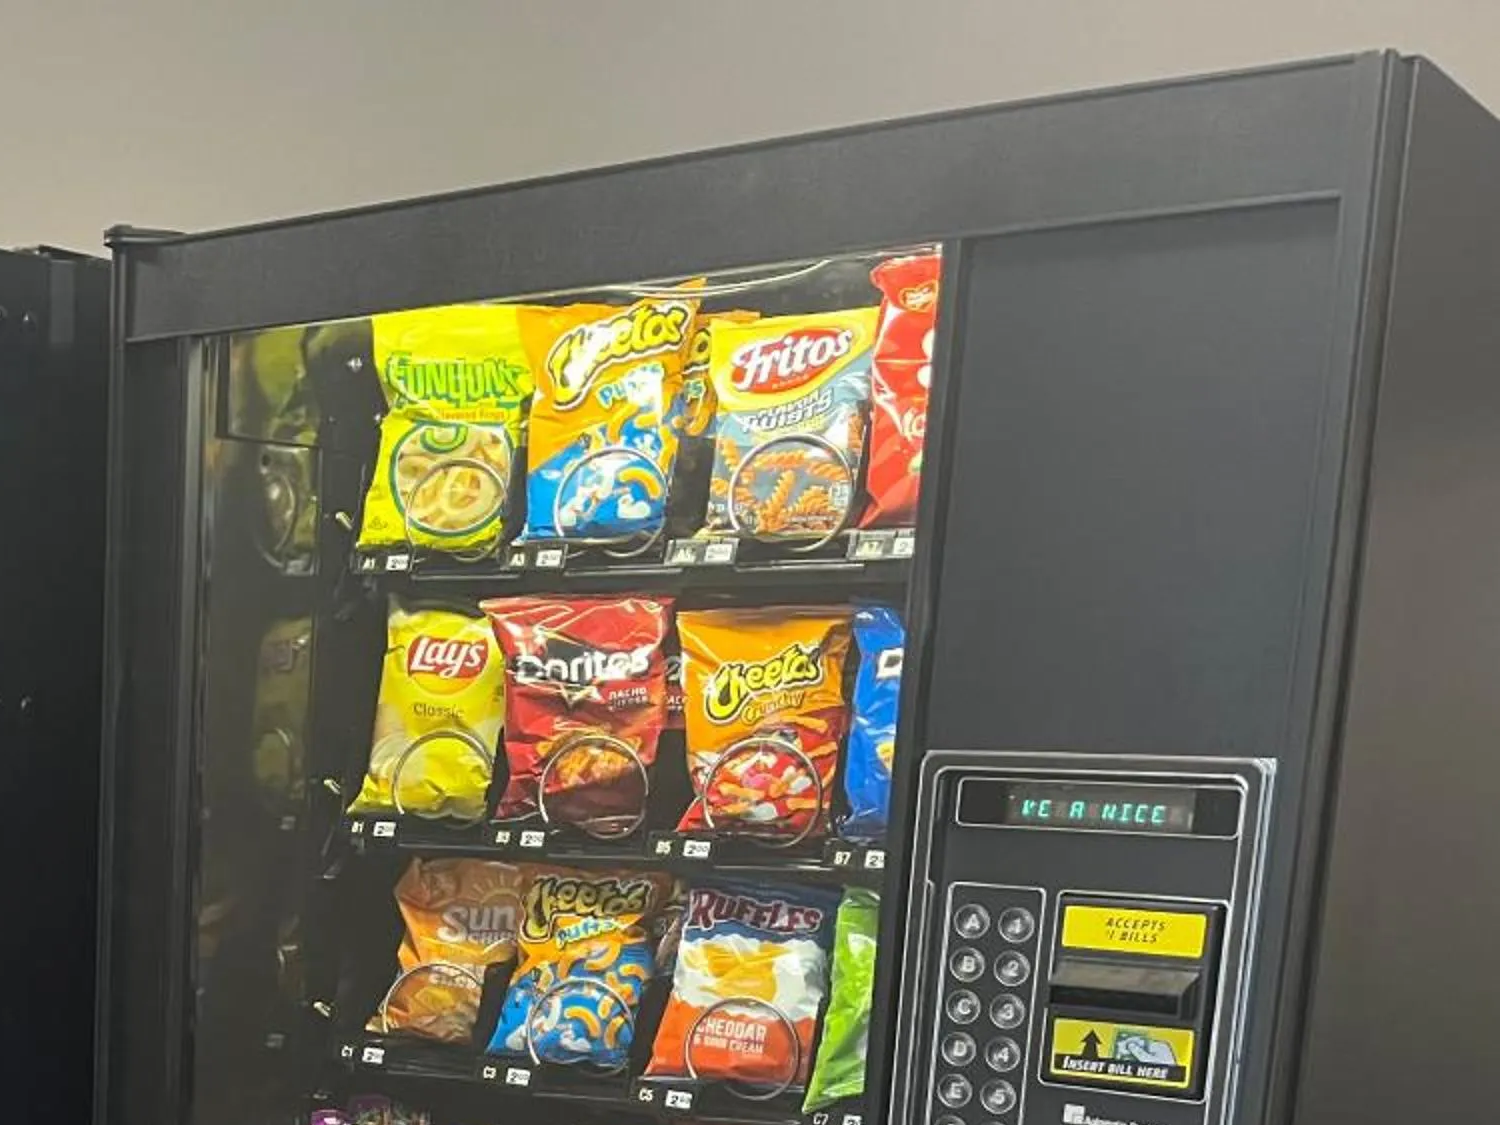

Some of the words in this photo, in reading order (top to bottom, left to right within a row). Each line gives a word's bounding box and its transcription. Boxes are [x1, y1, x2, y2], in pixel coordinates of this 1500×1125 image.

[548, 302, 689, 407] Cetos
[732, 329, 853, 389] Fritos
[514, 650, 649, 683] Doritos
[1069, 800, 1085, 819] A
[1101, 803, 1167, 823] NICE
[689, 889, 823, 935] RUFFLES
[966, 913, 980, 931] A
[1010, 917, 1022, 934] 1
[1105, 918, 1168, 931] ACCEPTS
[1119, 932, 1157, 943] BILLS
[962, 955, 975, 973] B
[1006, 959, 1019, 977] 2
[957, 998, 971, 1015] C
[1001, 1003, 1014, 1020] 3
[695, 1017, 767, 1041] CHEDDAR
[729, 1040, 764, 1054] CREAM
[953, 1040, 967, 1057] D
[1107, 1062, 1133, 1075] BILL
[1137, 1065, 1168, 1079] HERE
[638, 1088, 653, 1102] C5
[950, 1081, 963, 1099] E
[813, 1114, 829, 1125] C7
